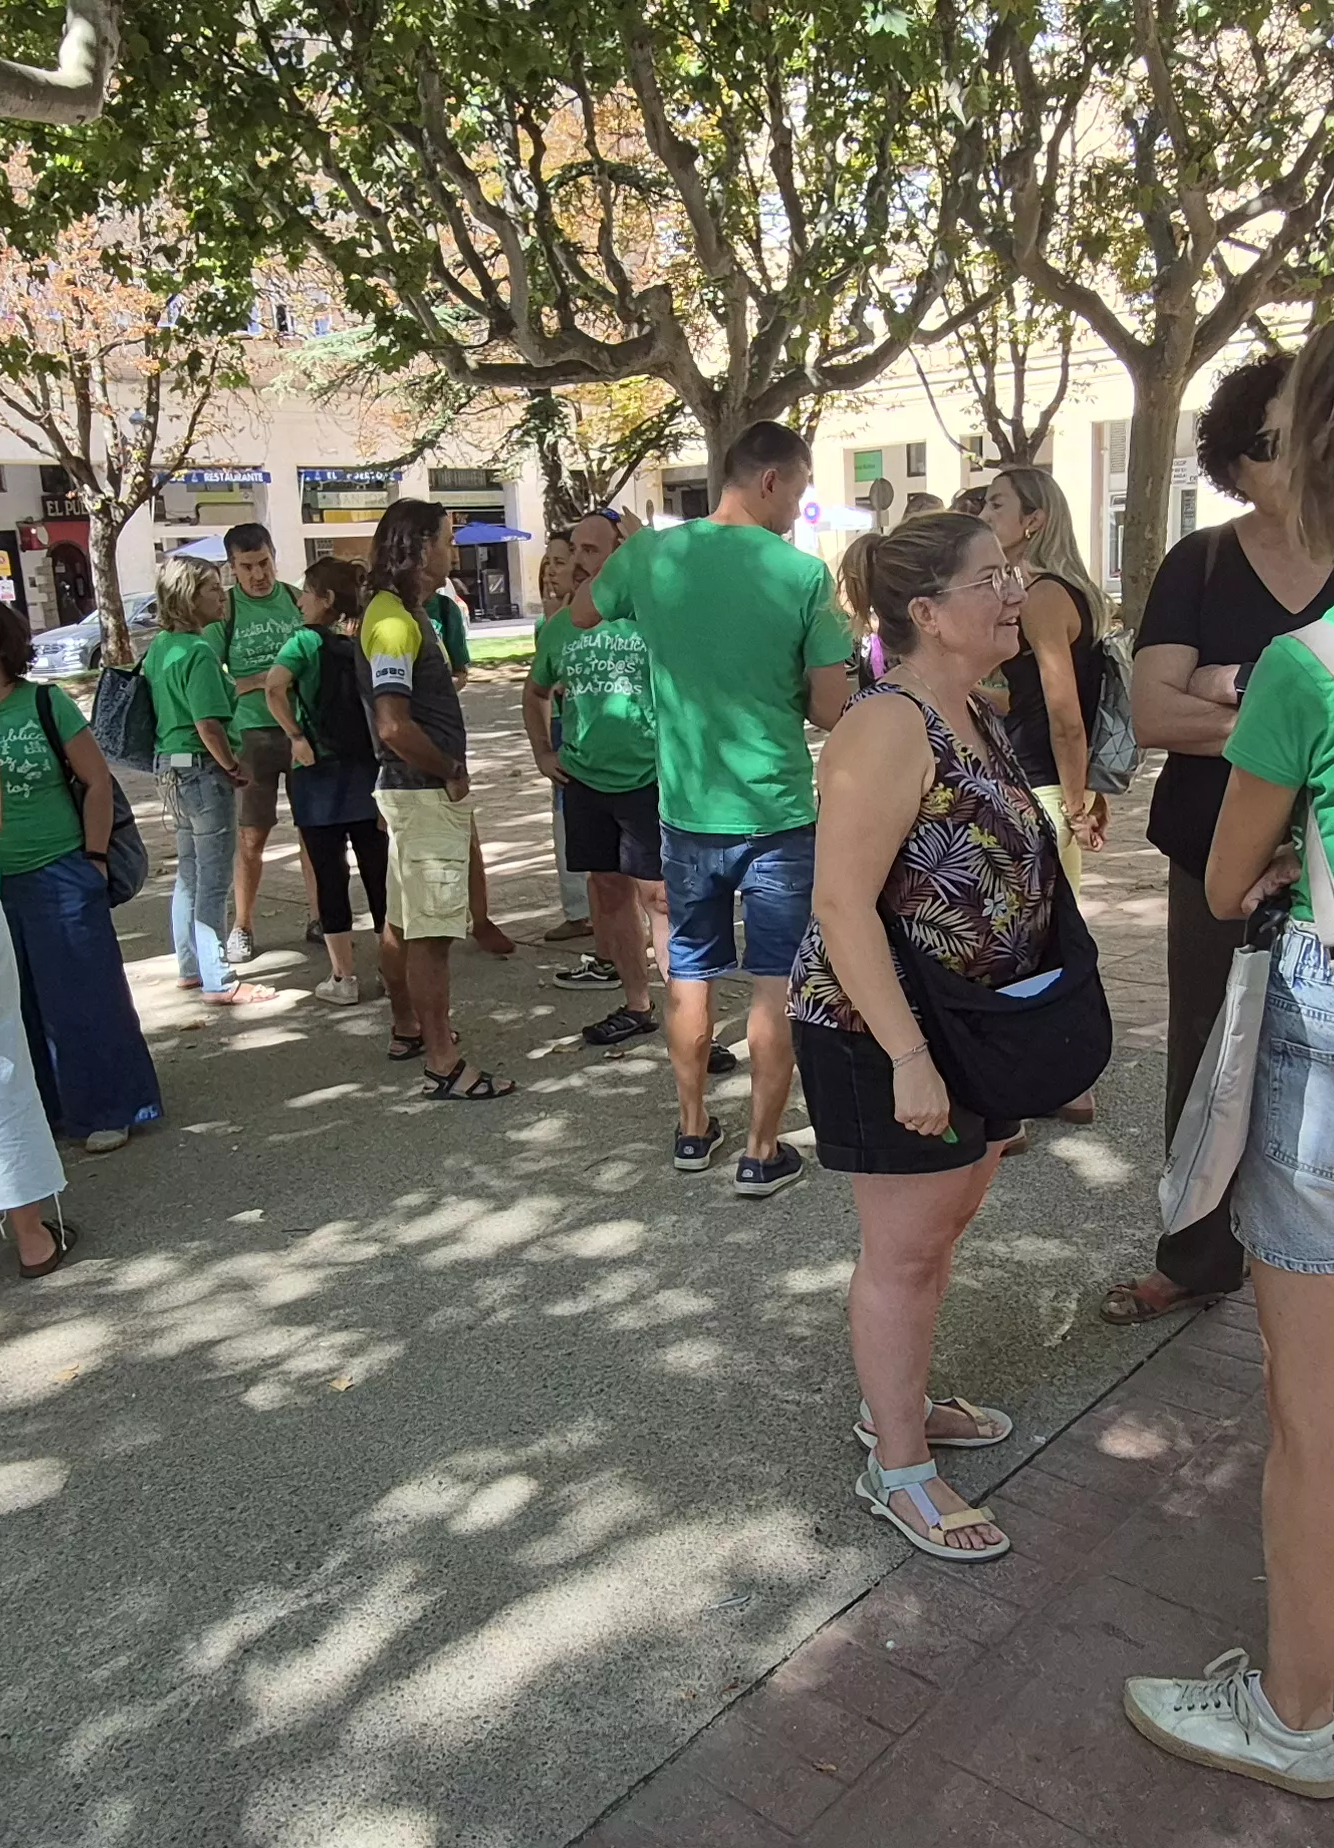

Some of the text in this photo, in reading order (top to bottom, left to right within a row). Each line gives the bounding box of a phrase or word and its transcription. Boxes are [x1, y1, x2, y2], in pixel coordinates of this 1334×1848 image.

[46, 500, 63, 517] EL
[567, 660, 636, 676] DE TOD@S
[597, 681, 643, 696] TOD@S
